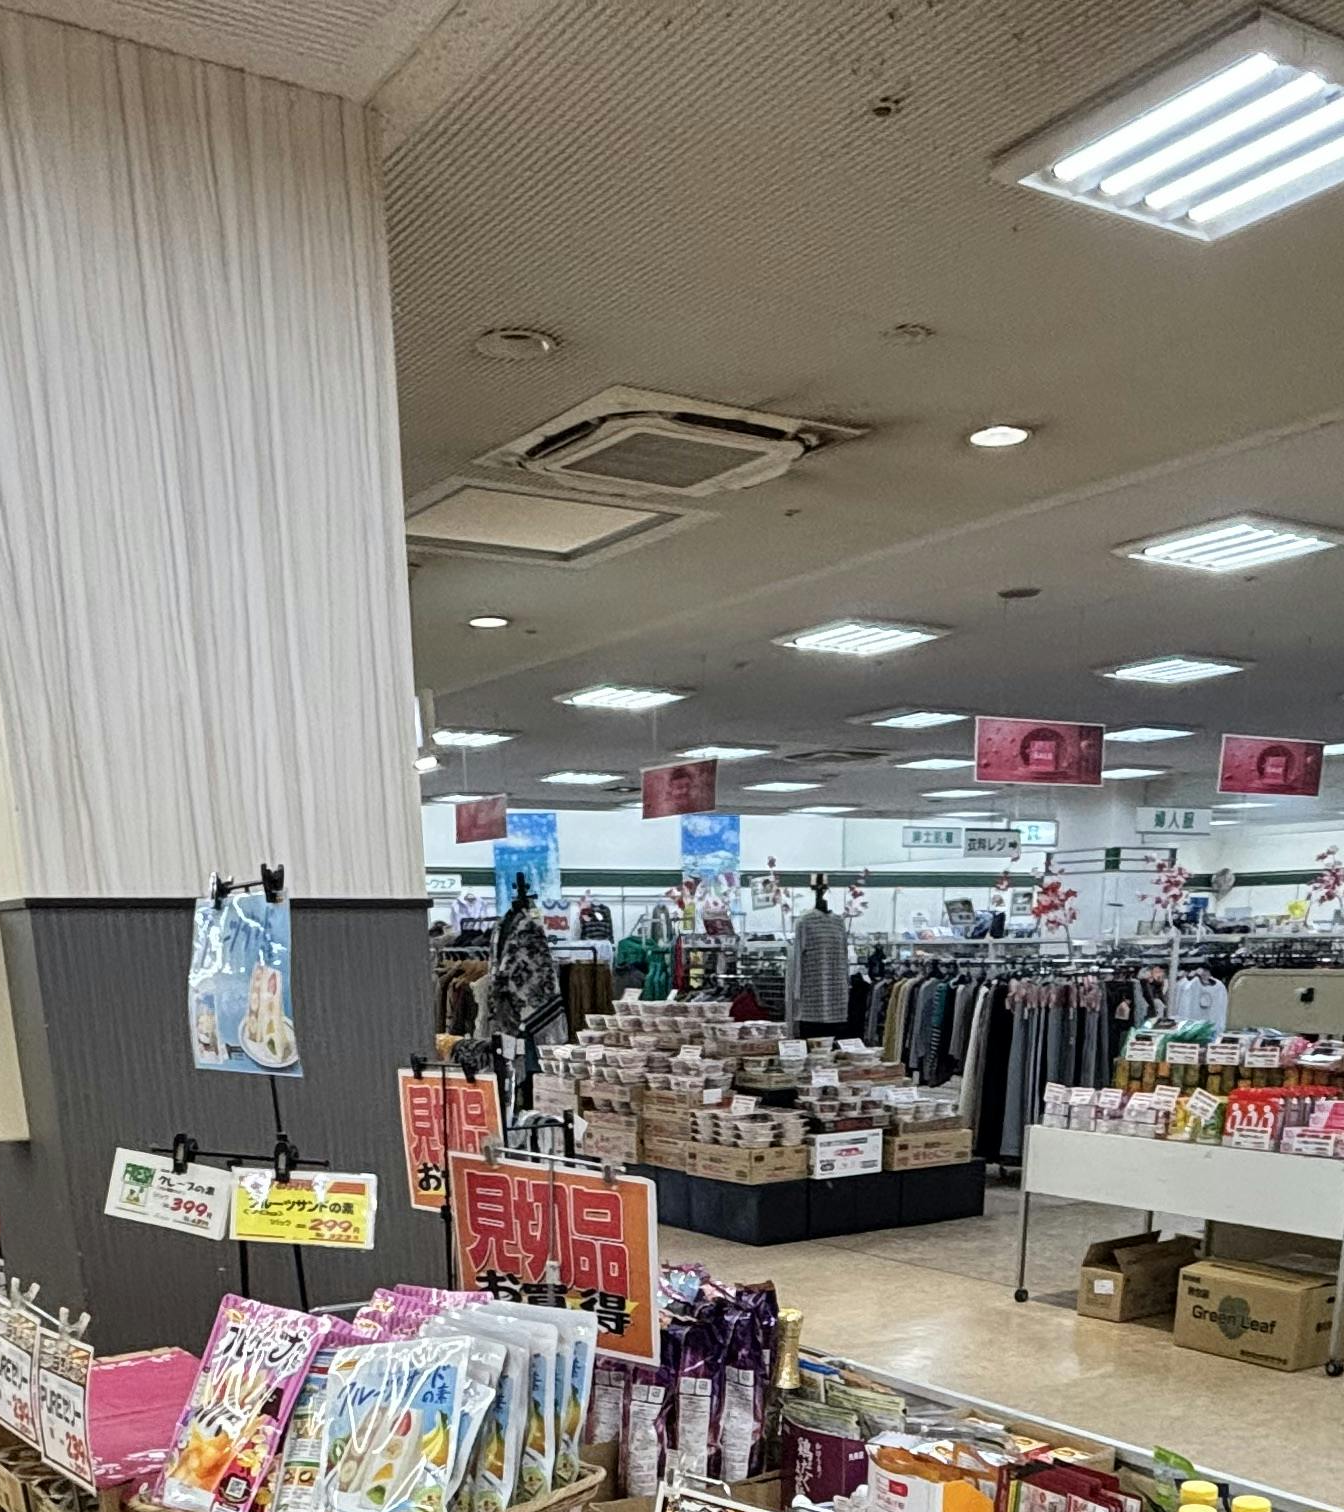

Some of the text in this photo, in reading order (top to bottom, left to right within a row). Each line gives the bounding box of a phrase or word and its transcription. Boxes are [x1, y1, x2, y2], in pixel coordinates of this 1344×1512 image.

[967, 837, 1006, 852] 衣料レジ
[1192, 1304, 1277, 1335] Green Leaf
